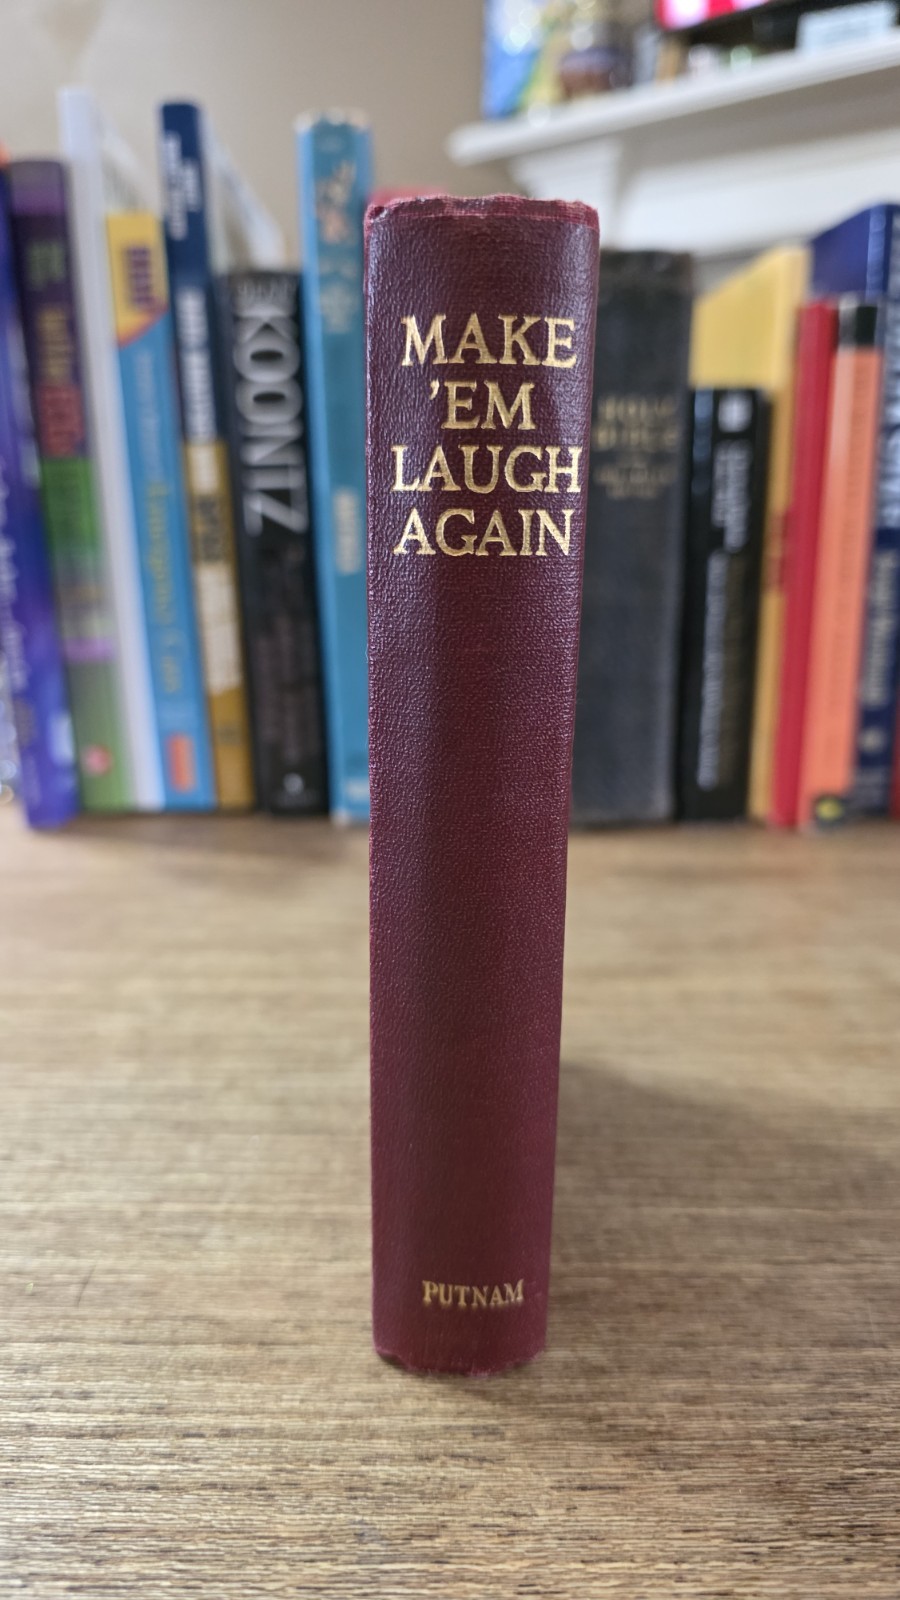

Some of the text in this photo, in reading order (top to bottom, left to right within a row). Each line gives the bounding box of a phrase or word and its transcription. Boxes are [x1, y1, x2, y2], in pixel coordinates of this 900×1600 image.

[400, 313, 577, 368] MAKE
[233, 303, 308, 536] KOONTZ
[430, 380, 536, 430] 'EM
[391, 444, 582, 494] LAUGH
[393, 508, 573, 557] AGAIN
[422, 1279, 525, 1308] PUTNAM
